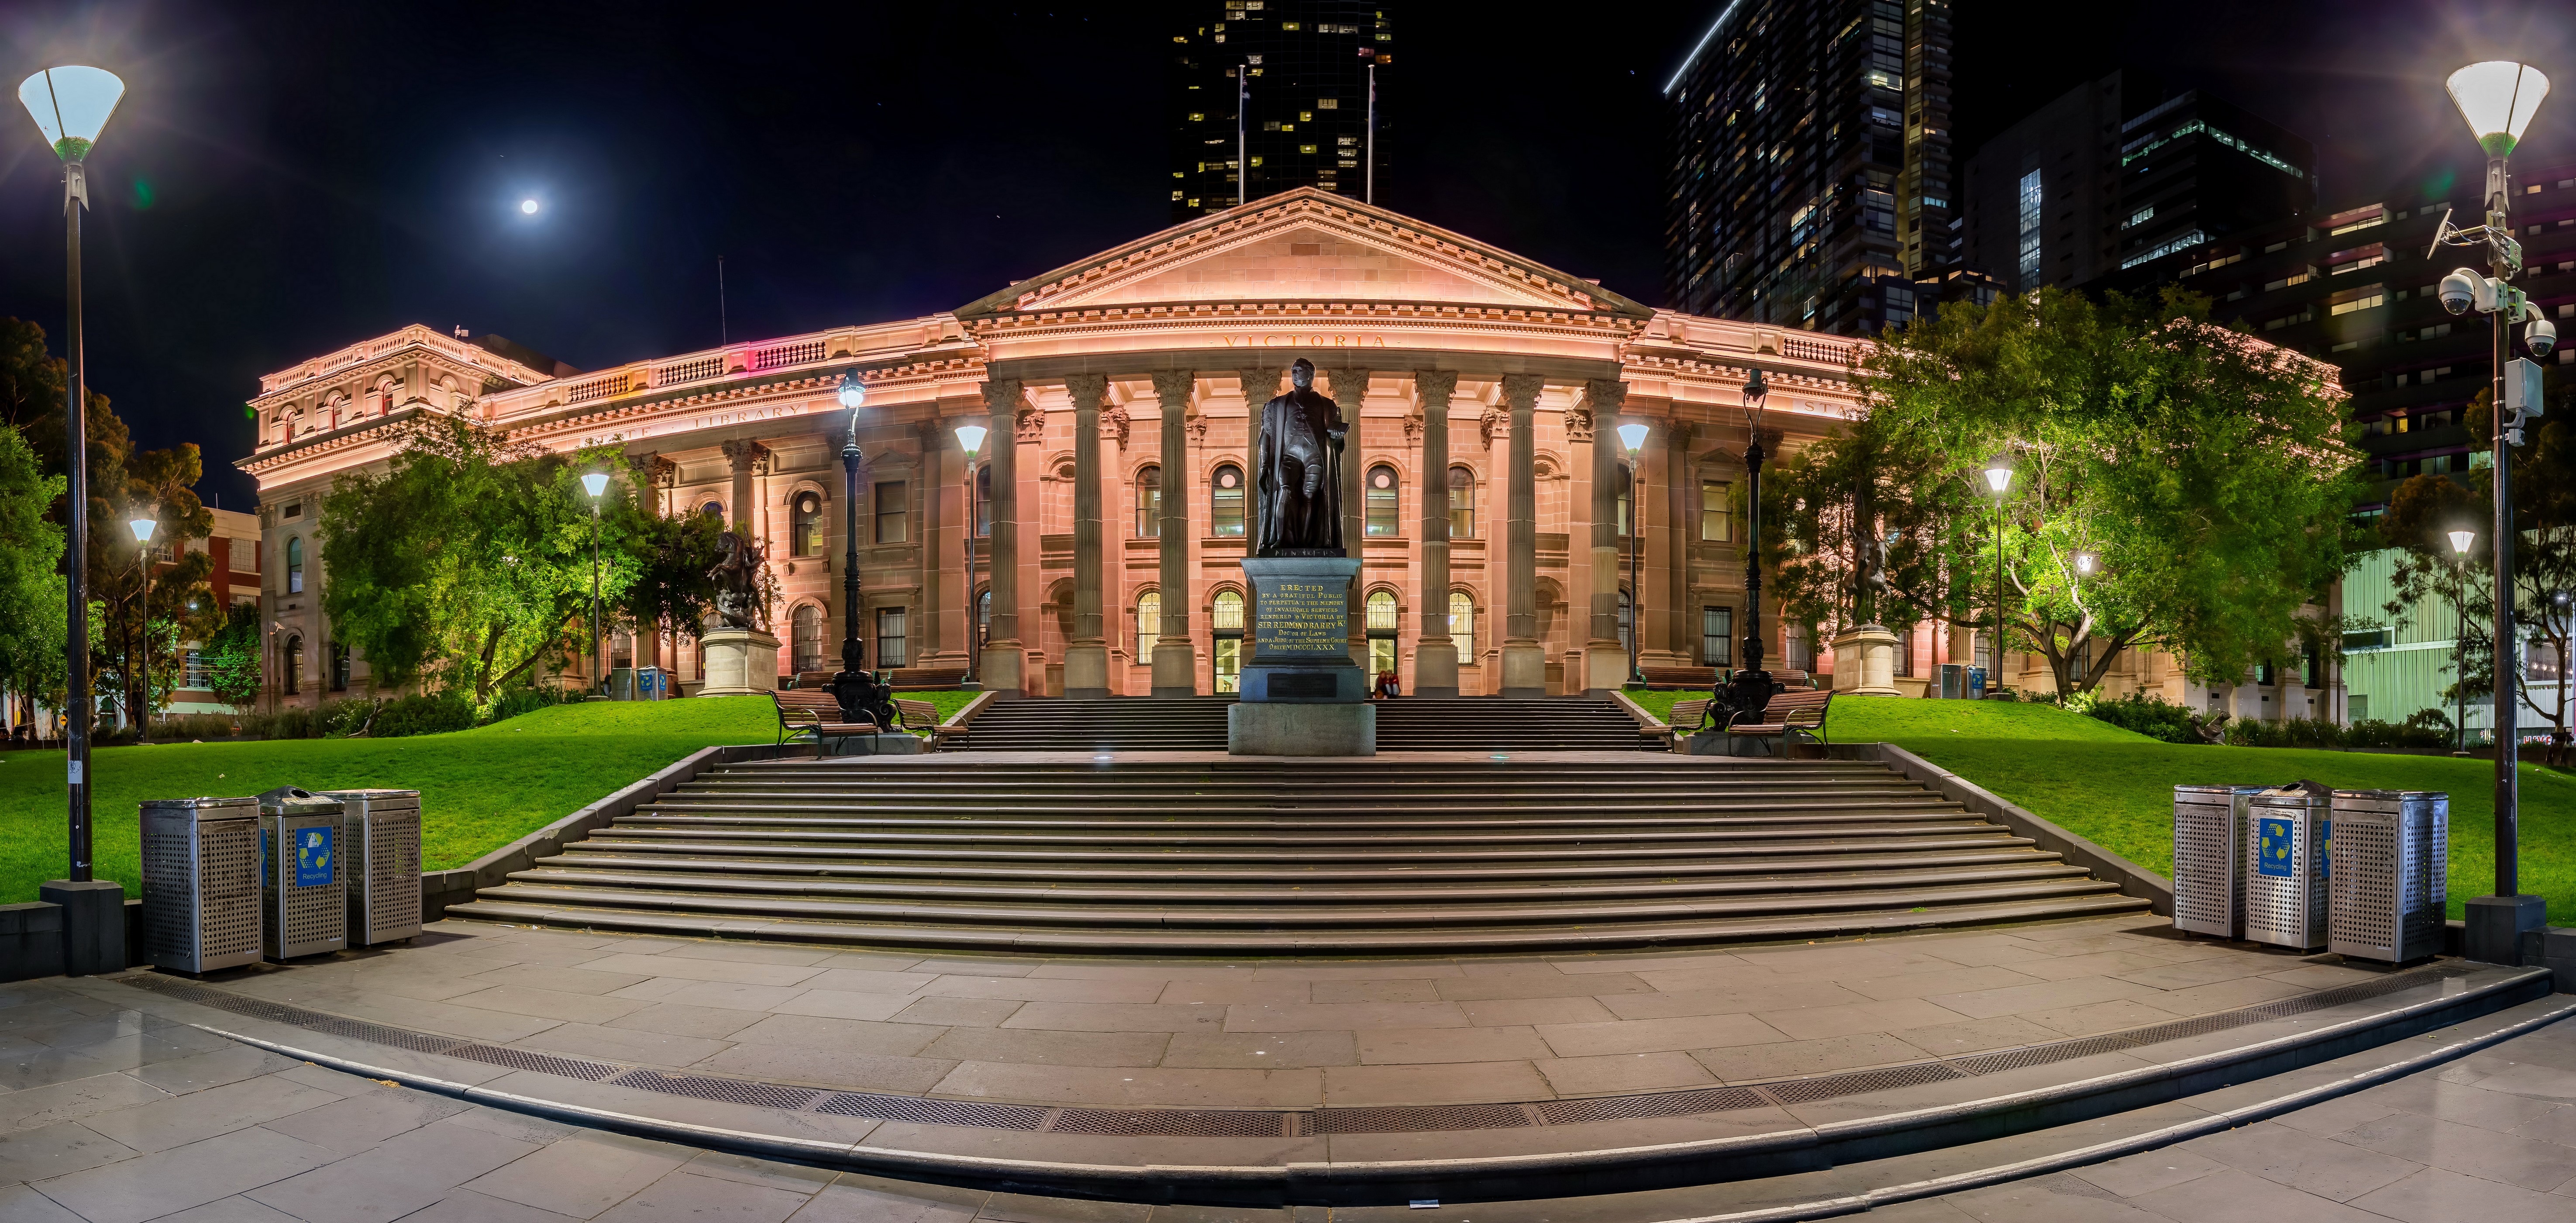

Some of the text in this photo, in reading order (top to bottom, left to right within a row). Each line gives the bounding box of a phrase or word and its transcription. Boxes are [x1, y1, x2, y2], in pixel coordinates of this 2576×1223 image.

[1222, 334, 1386, 347] VICTORIA
[695, 404, 802, 429] LIBRARY
[2264, 863, 2287, 871] Recycling
